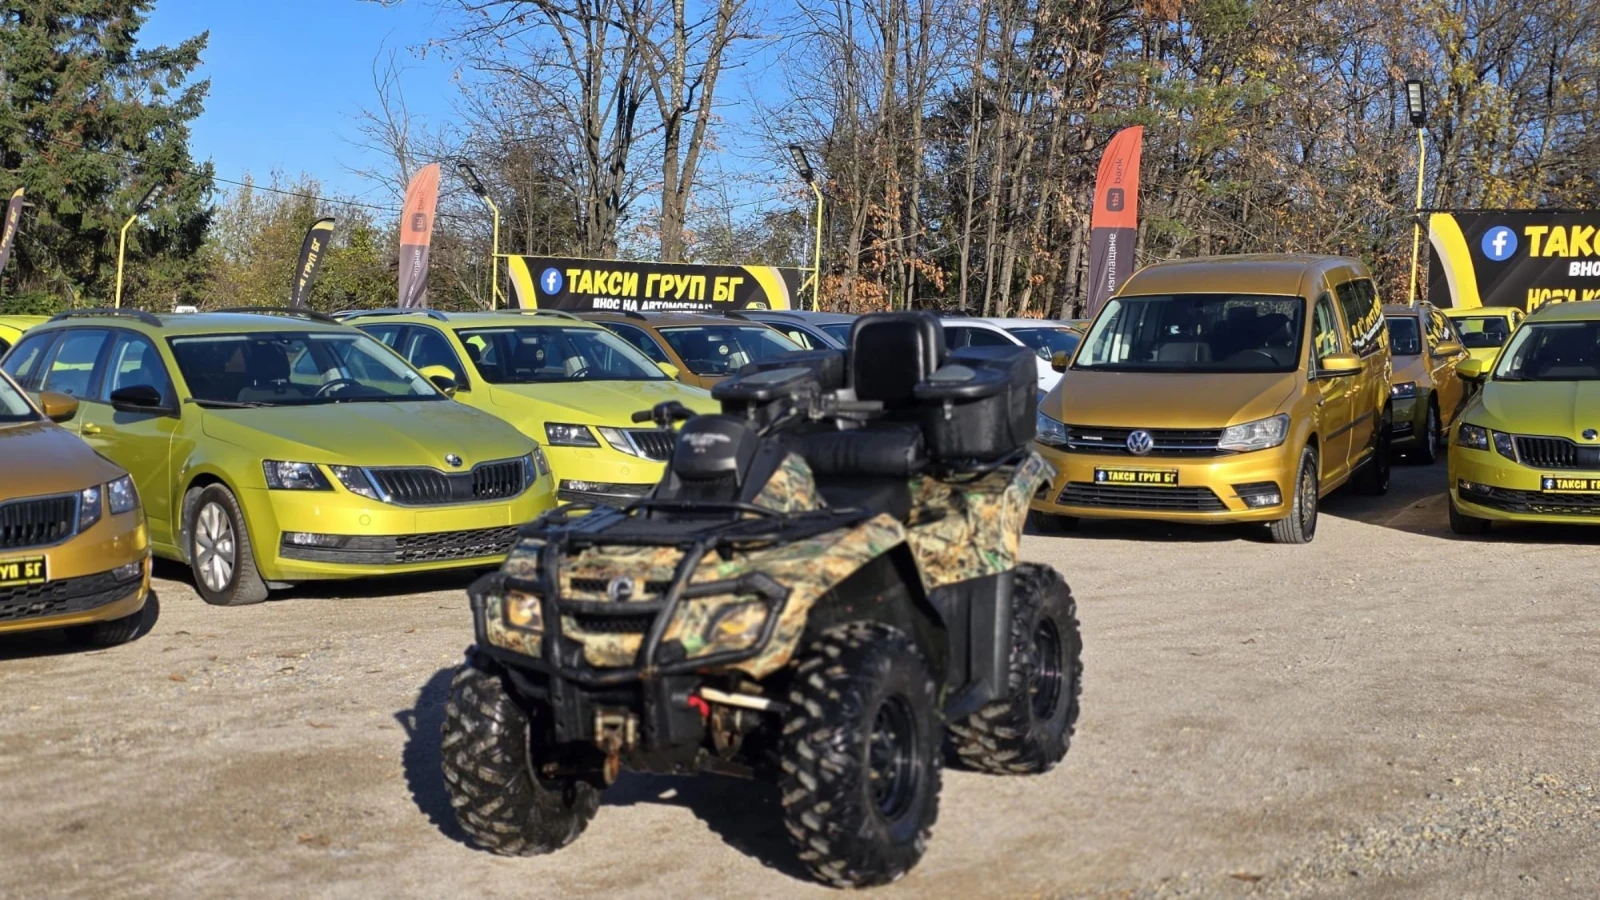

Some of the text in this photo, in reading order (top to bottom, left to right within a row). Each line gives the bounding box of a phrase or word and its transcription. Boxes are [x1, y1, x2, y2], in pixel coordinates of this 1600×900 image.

[1112, 192, 1120, 207] tbi
[1525, 225, 1600, 257] ТАК
[302, 252, 318, 278] ГРУП
[1107, 233, 1117, 292] изплащане
[566, 269, 743, 302] ТАКСИ ГРУП БГ
[592, 297, 621, 310] ВНОС
[622, 299, 638, 312] НА
[1107, 471, 1176, 483] ТАКСИ ГРУП БГ
[1556, 479, 1588, 490] ТАКСИ
[25, 562, 42, 577] БГ
